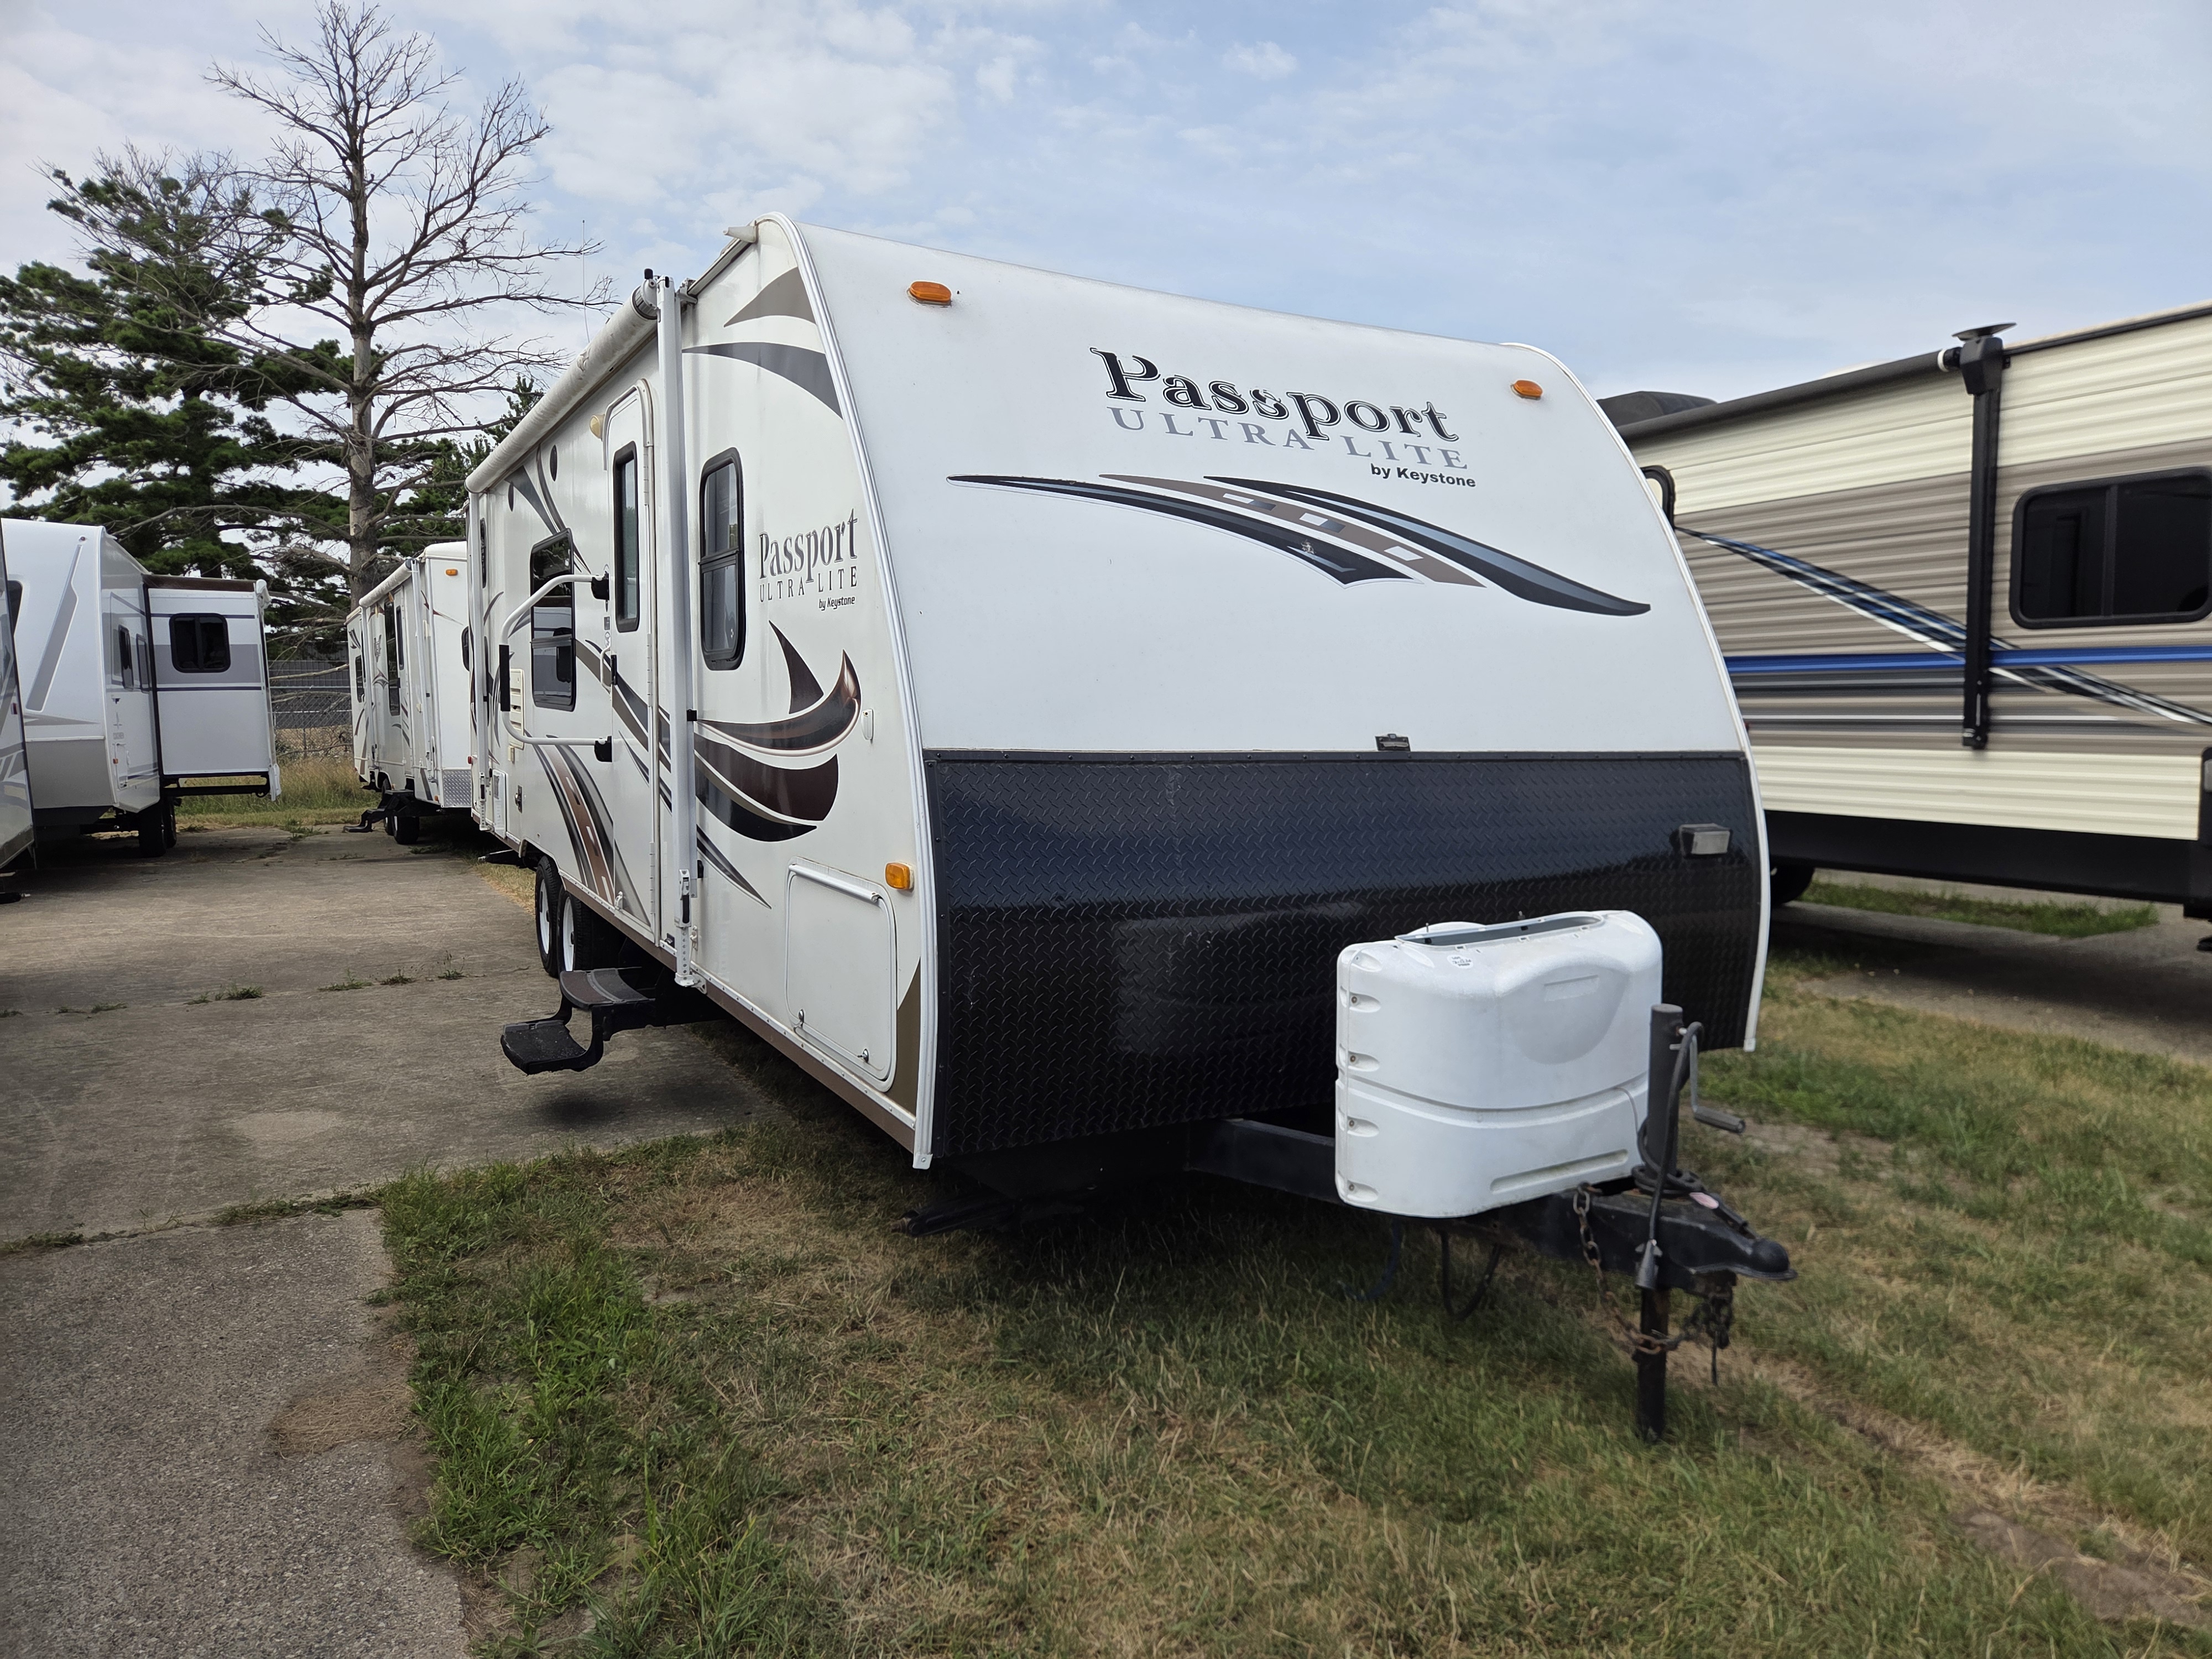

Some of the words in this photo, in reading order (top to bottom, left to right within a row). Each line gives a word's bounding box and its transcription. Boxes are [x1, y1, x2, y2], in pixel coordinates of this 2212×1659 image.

[1089, 347, 1459, 442] Passport
[1107, 406, 1315, 451] ULTRA
[1340, 435, 1468, 470] LITE
[1371, 463, 1390, 479] by
[1397, 467, 1476, 488] Keystone
[759, 508, 858, 583] Passport
[759, 576, 805, 602] ULTRA
[818, 566, 857, 592] LITE
[818, 598, 826, 611] by
[827, 596, 855, 609] Keystone
